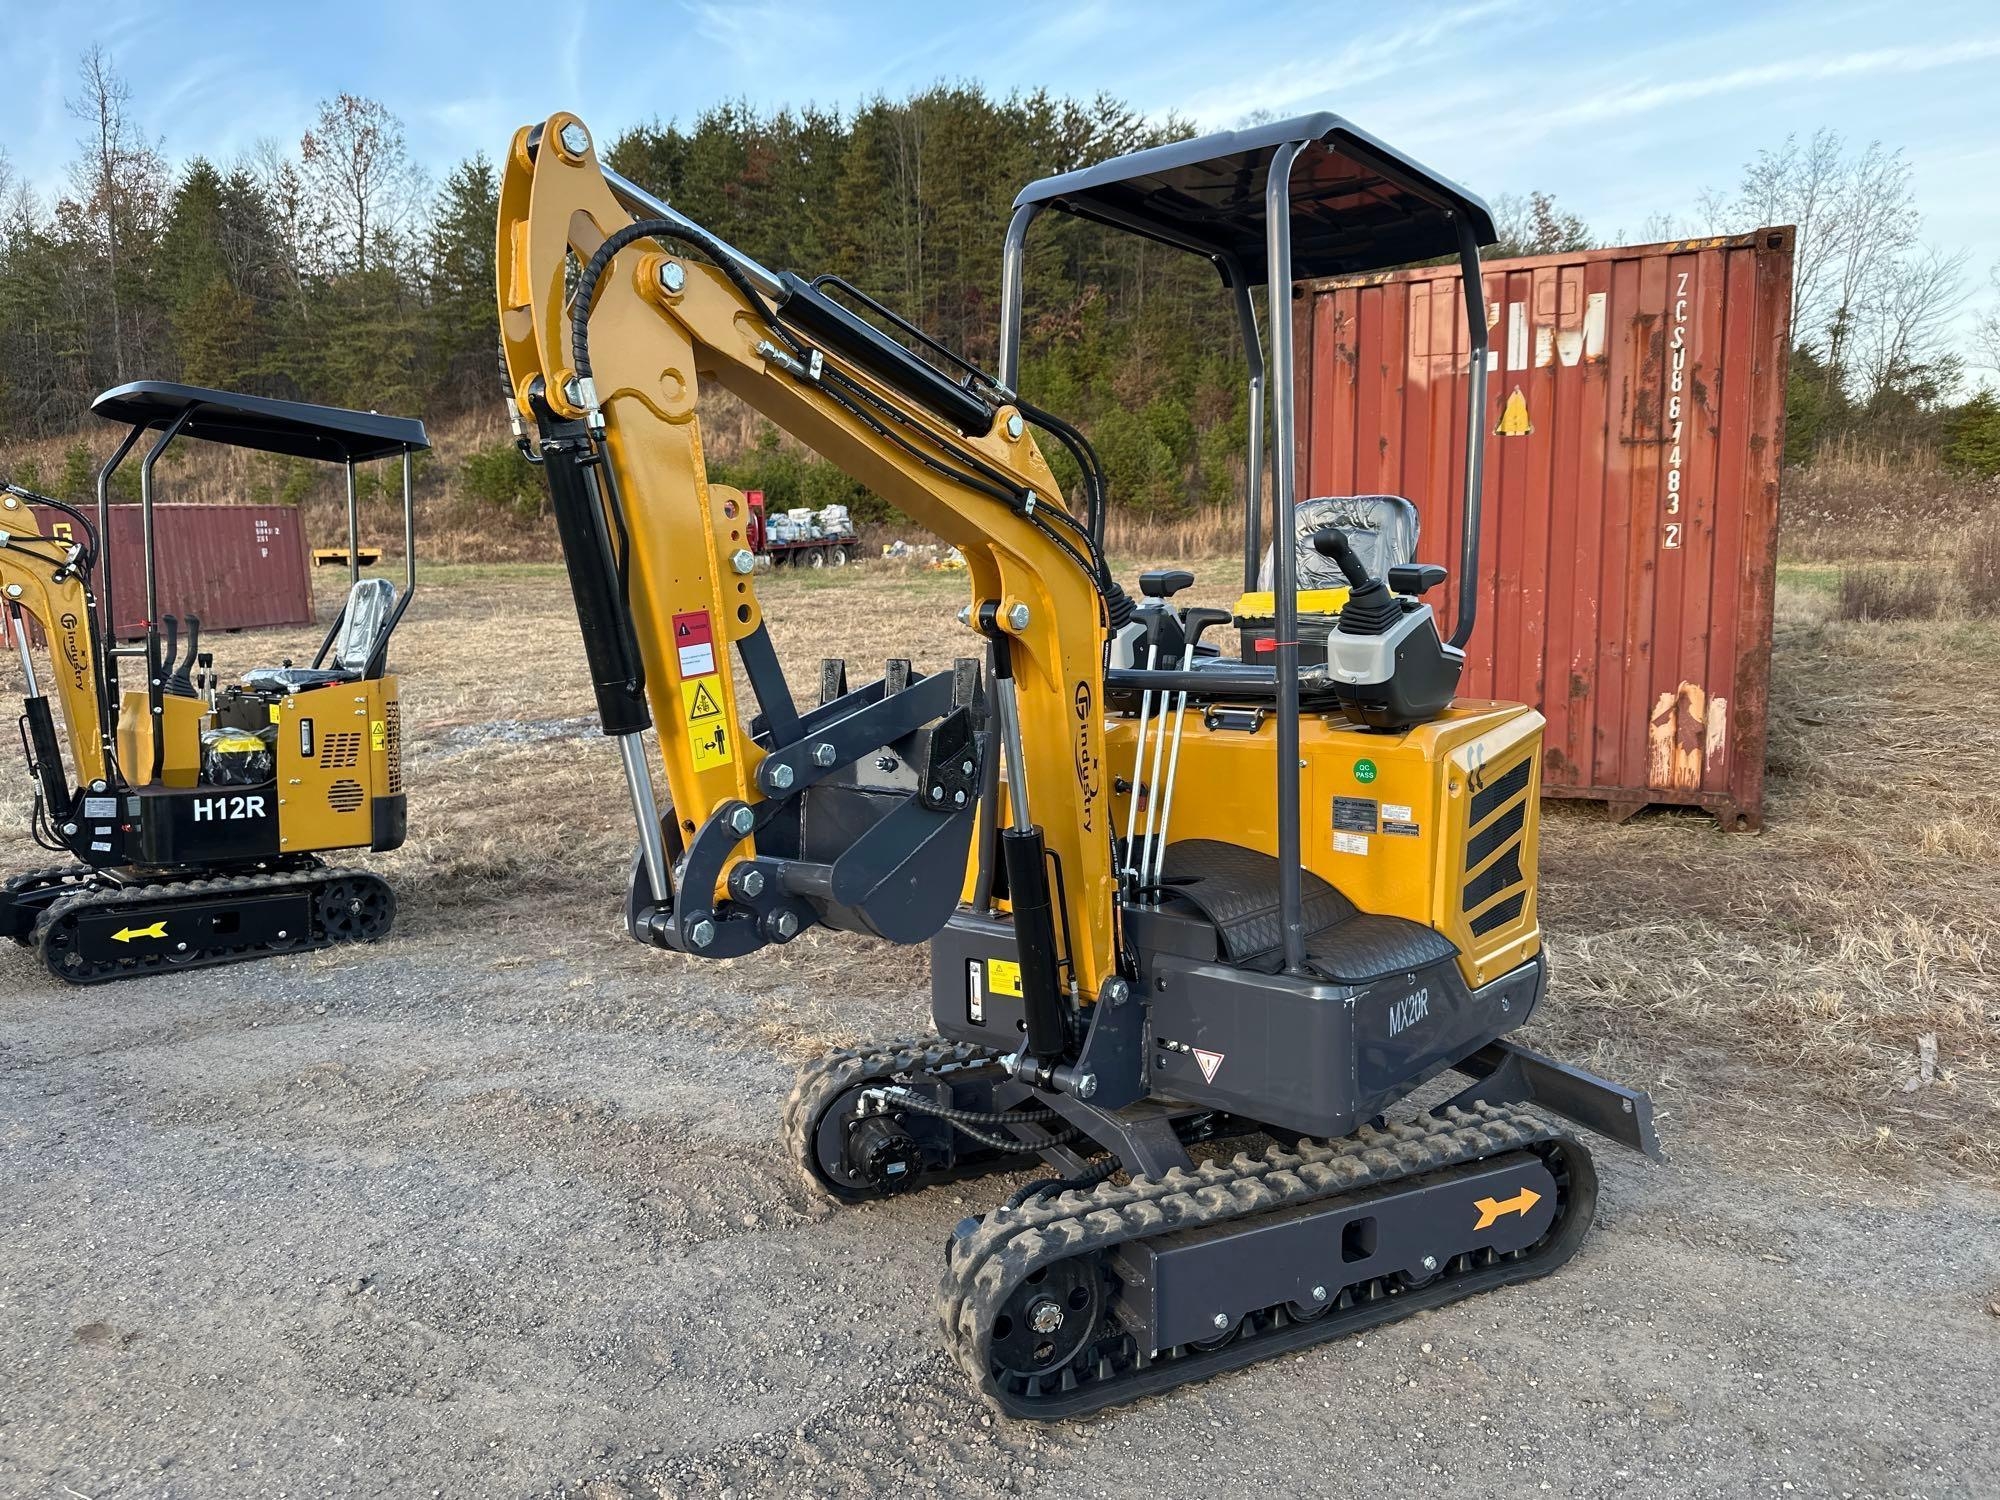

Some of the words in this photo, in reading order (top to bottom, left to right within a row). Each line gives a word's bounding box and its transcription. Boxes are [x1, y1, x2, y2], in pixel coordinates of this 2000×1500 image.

[1355, 771, 1374, 780] PASS
[1359, 764, 1370, 772] QC
[193, 796, 266, 822] H12R
[1388, 988, 1429, 1038] MX20R
